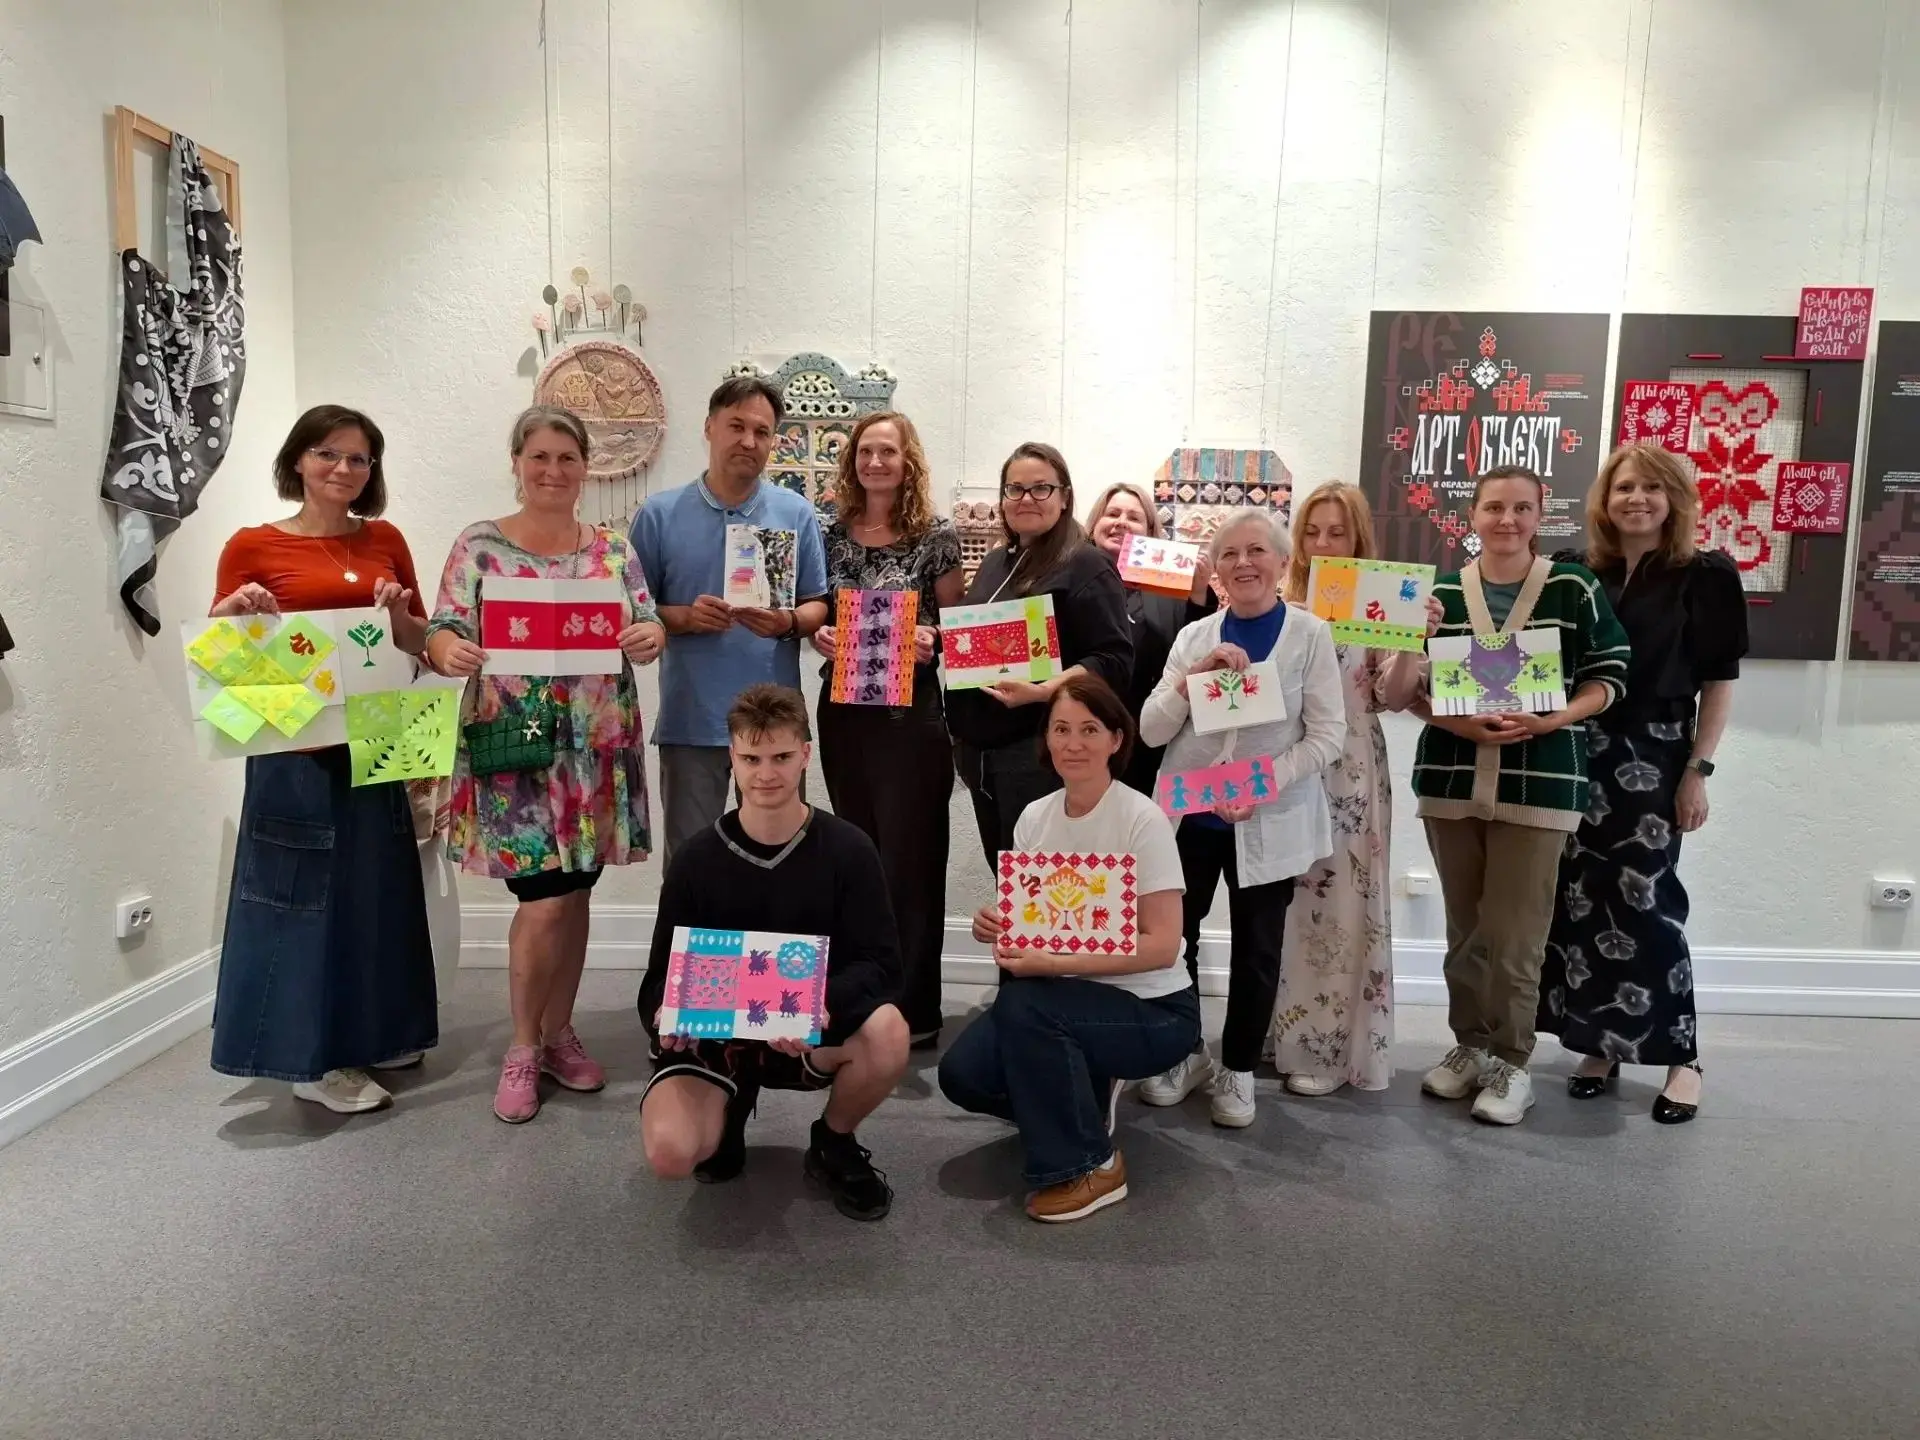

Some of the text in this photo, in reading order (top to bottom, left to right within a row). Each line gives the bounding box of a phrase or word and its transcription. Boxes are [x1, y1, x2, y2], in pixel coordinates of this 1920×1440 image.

[1630, 385, 1658, 400] МЫ
[1411, 414, 1561, 477] АРТ-ОБЪЕКТ
[1782, 465, 1817, 481] МОЩЬ
